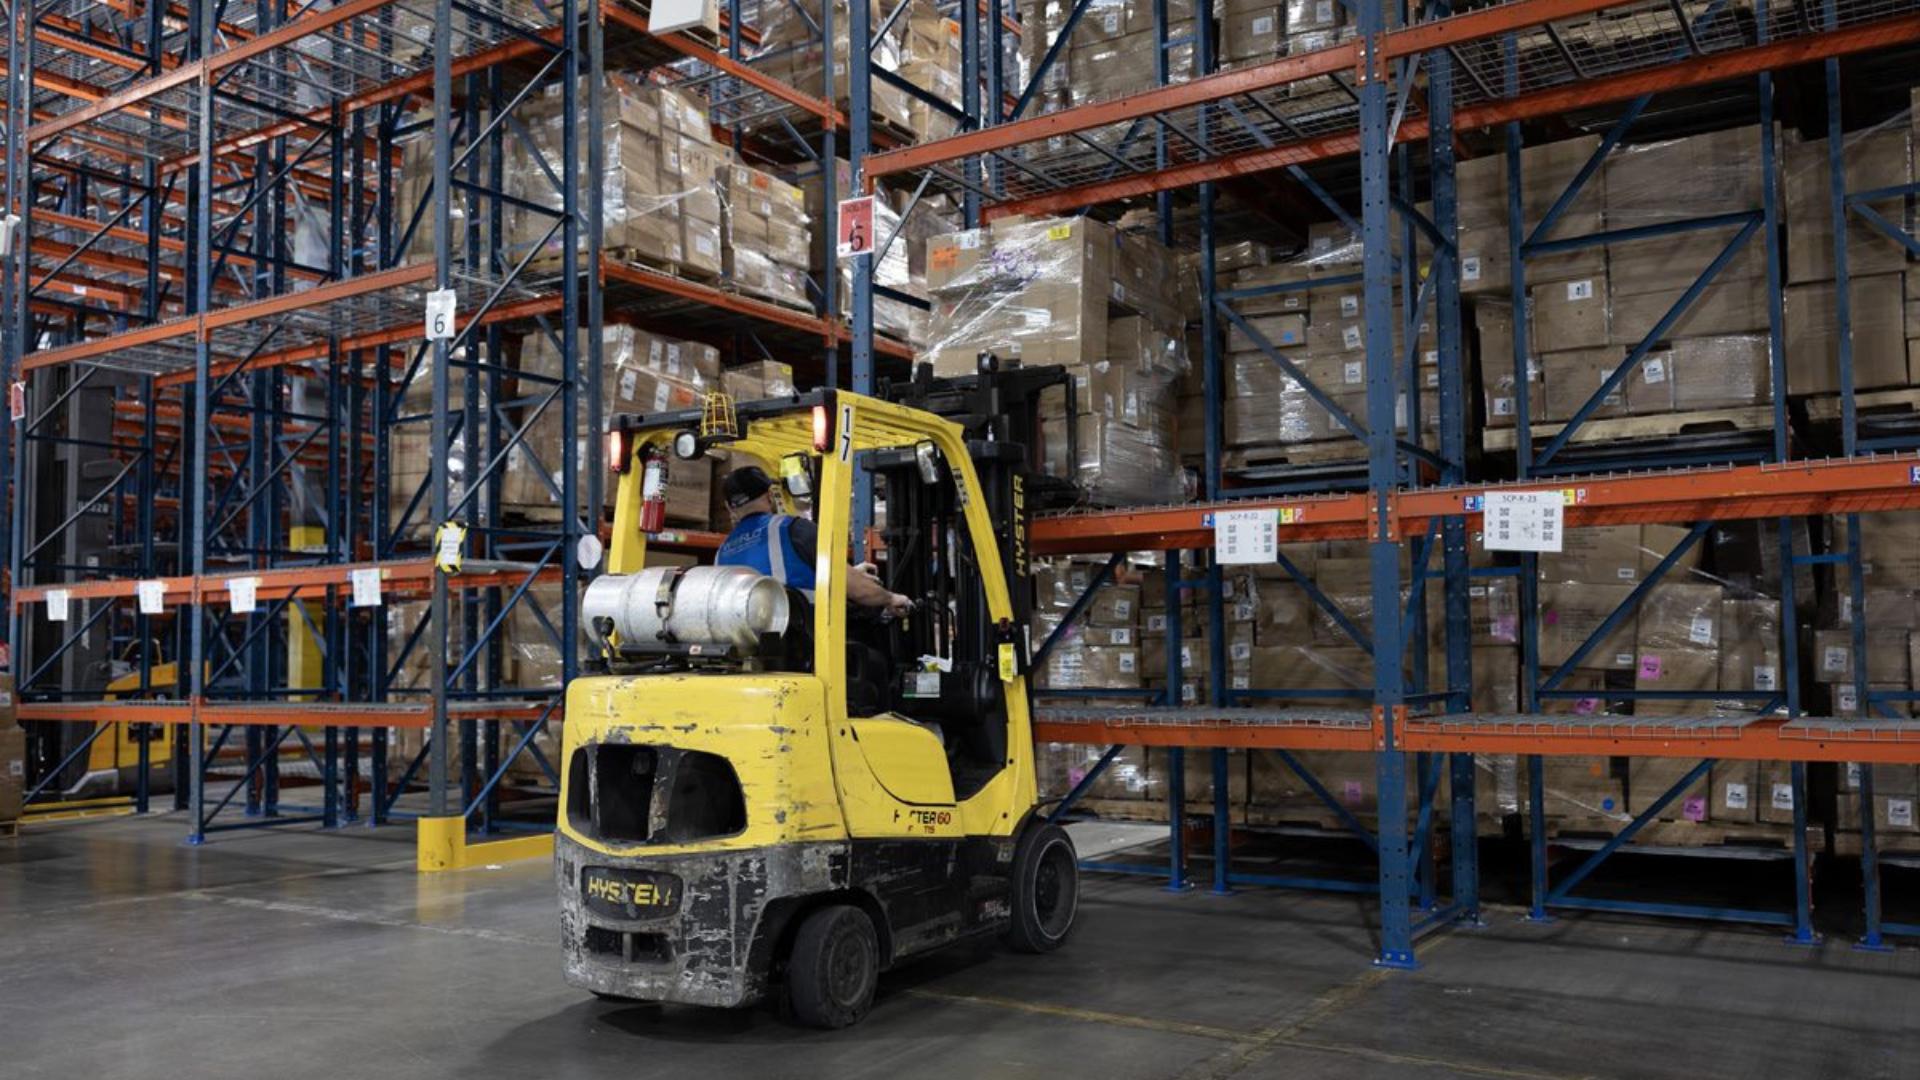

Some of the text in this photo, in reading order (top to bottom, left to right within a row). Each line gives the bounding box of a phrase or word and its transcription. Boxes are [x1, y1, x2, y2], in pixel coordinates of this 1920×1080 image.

[434, 312, 446, 334] 6
[842, 408, 851, 461] 17
[1013, 474, 1025, 577] HYSTER
[893, 809, 951, 825] HTER 60
